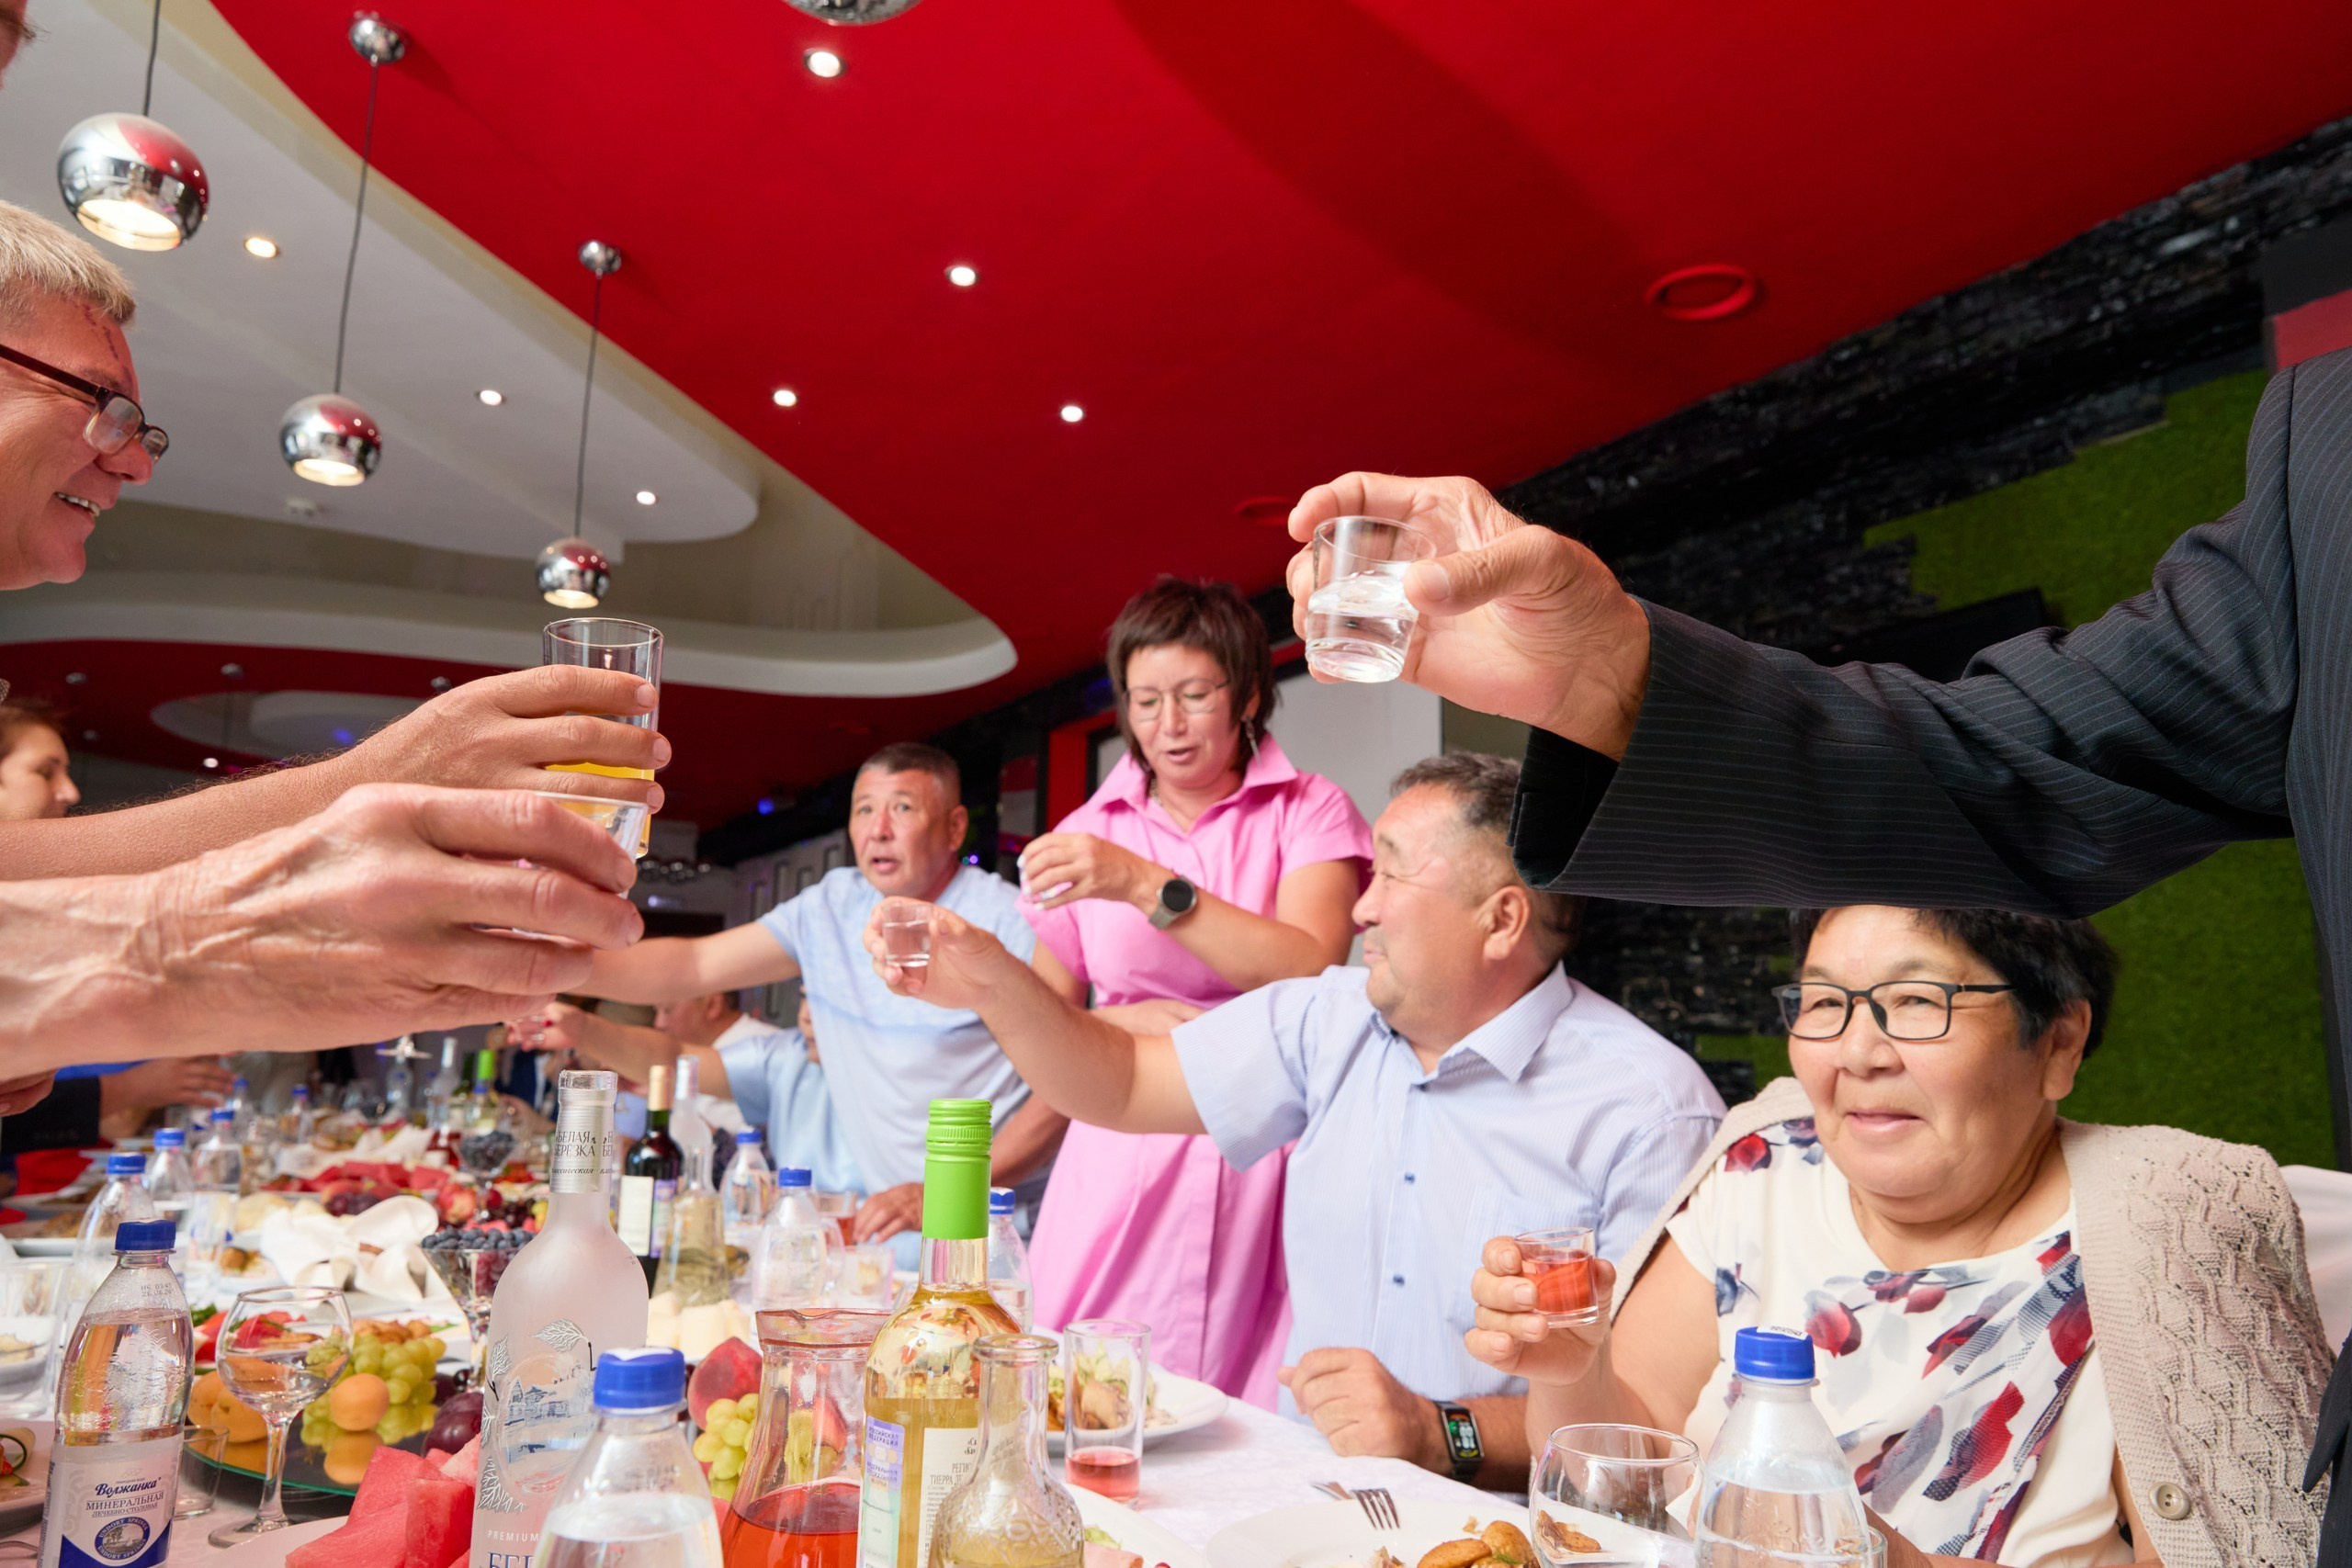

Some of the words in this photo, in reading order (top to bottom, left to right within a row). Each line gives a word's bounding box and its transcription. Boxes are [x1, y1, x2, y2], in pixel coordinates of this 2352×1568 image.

[95, 1481, 158, 1498] Волжанка
[85, 1492, 164, 1510] МИНЕРАЛЬНАЯ
[98, 1518, 125, 1538] UNDORY
[128, 1517, 148, 1530] SPRINGS
[488, 1529, 538, 1542] PREMIUM
[97, 1545, 121, 1560] UNDORY
